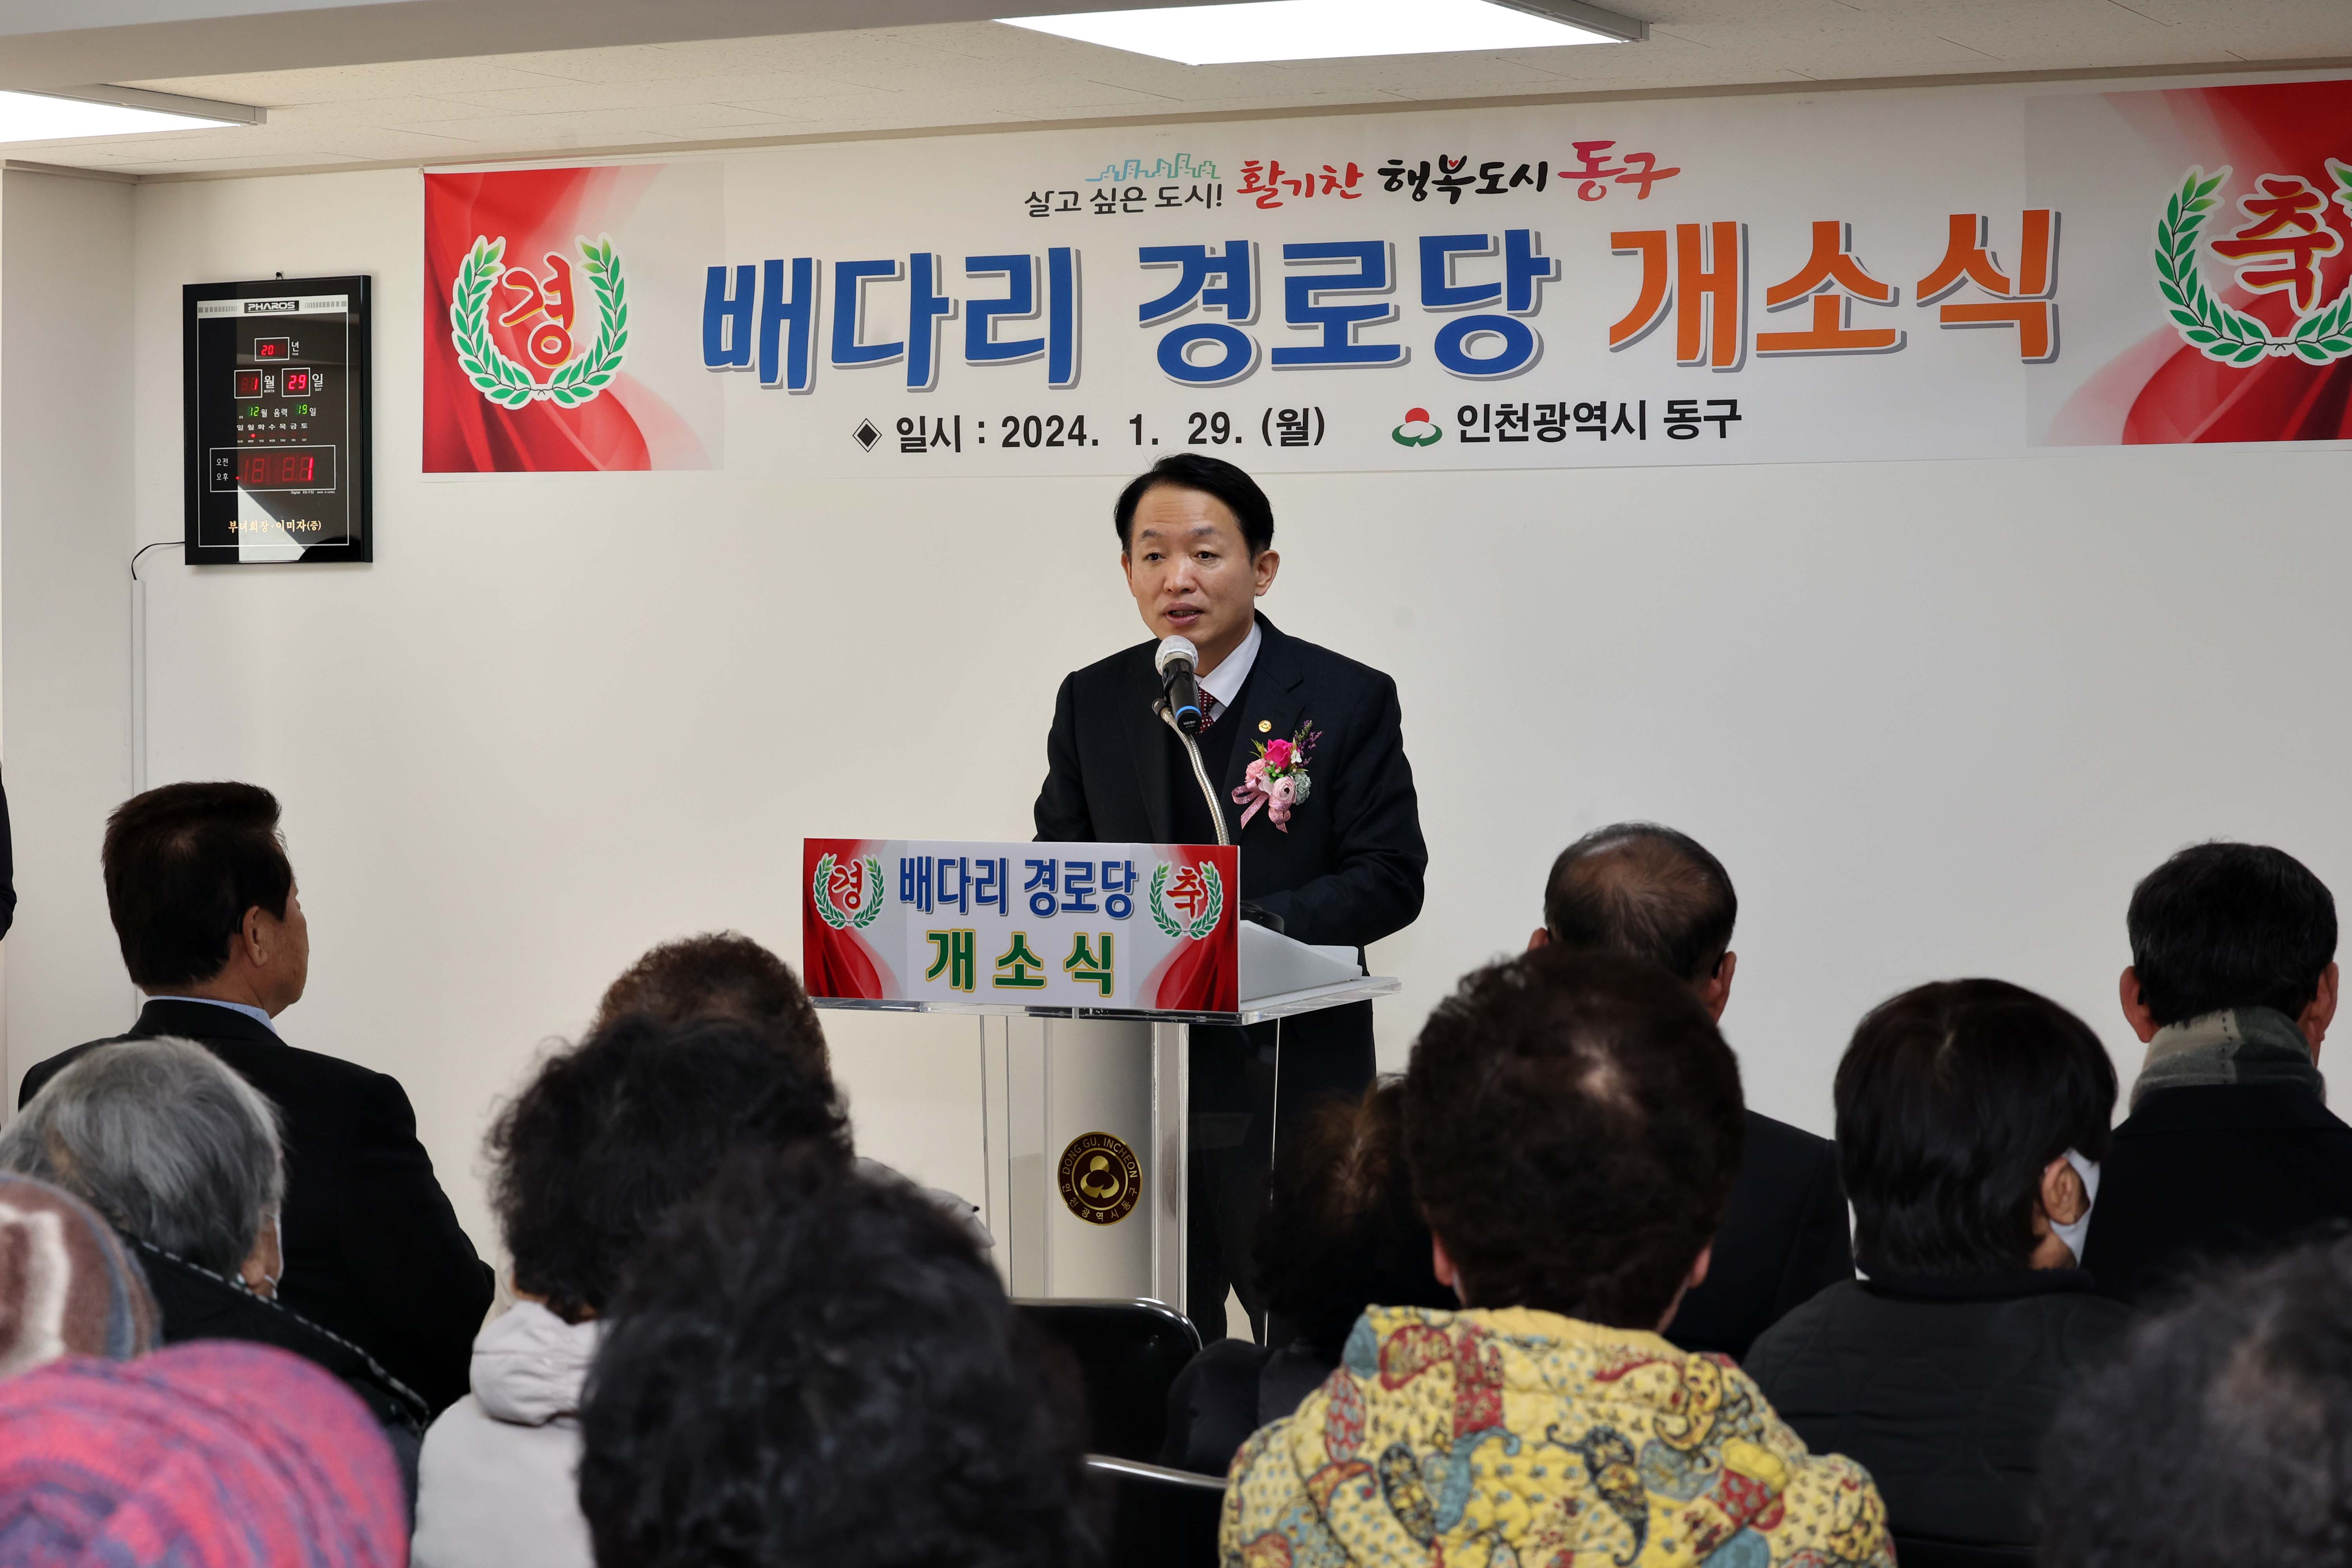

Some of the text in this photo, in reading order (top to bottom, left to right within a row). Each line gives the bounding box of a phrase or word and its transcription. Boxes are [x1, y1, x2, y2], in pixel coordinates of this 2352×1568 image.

[1024, 140, 1681, 218] 살고 싶은 도시! 활기찬 행복도시 동구
[2211, 179, 2336, 312] 축
[248, 302, 295, 310] PHAROS
[501, 254, 574, 368] 경
[702, 208, 2061, 392] 배다리 경로당 개소식
[291, 341, 299, 352] 년
[264, 375, 275, 389] 월
[288, 374, 307, 389] 29
[312, 374, 323, 387] 일
[274, 408, 287, 417] 음력
[896, 415, 962, 453] 일시
[1001, 415, 1099, 448] 2024.
[1129, 414, 1159, 445] 1.
[1188, 411, 1242, 444] 29.
[1261, 407, 1325, 448] (월)
[1457, 399, 1742, 443] 인천광역시 동구
[216, 458, 228, 466] 오전
[216, 473, 229, 481] 오후
[831, 860, 864, 912] 경
[899, 855, 1139, 920] 배다리 경로당
[1166, 865, 1203, 919] 축
[1062, 1136, 1138, 1178] DONG GU, INCHEON
